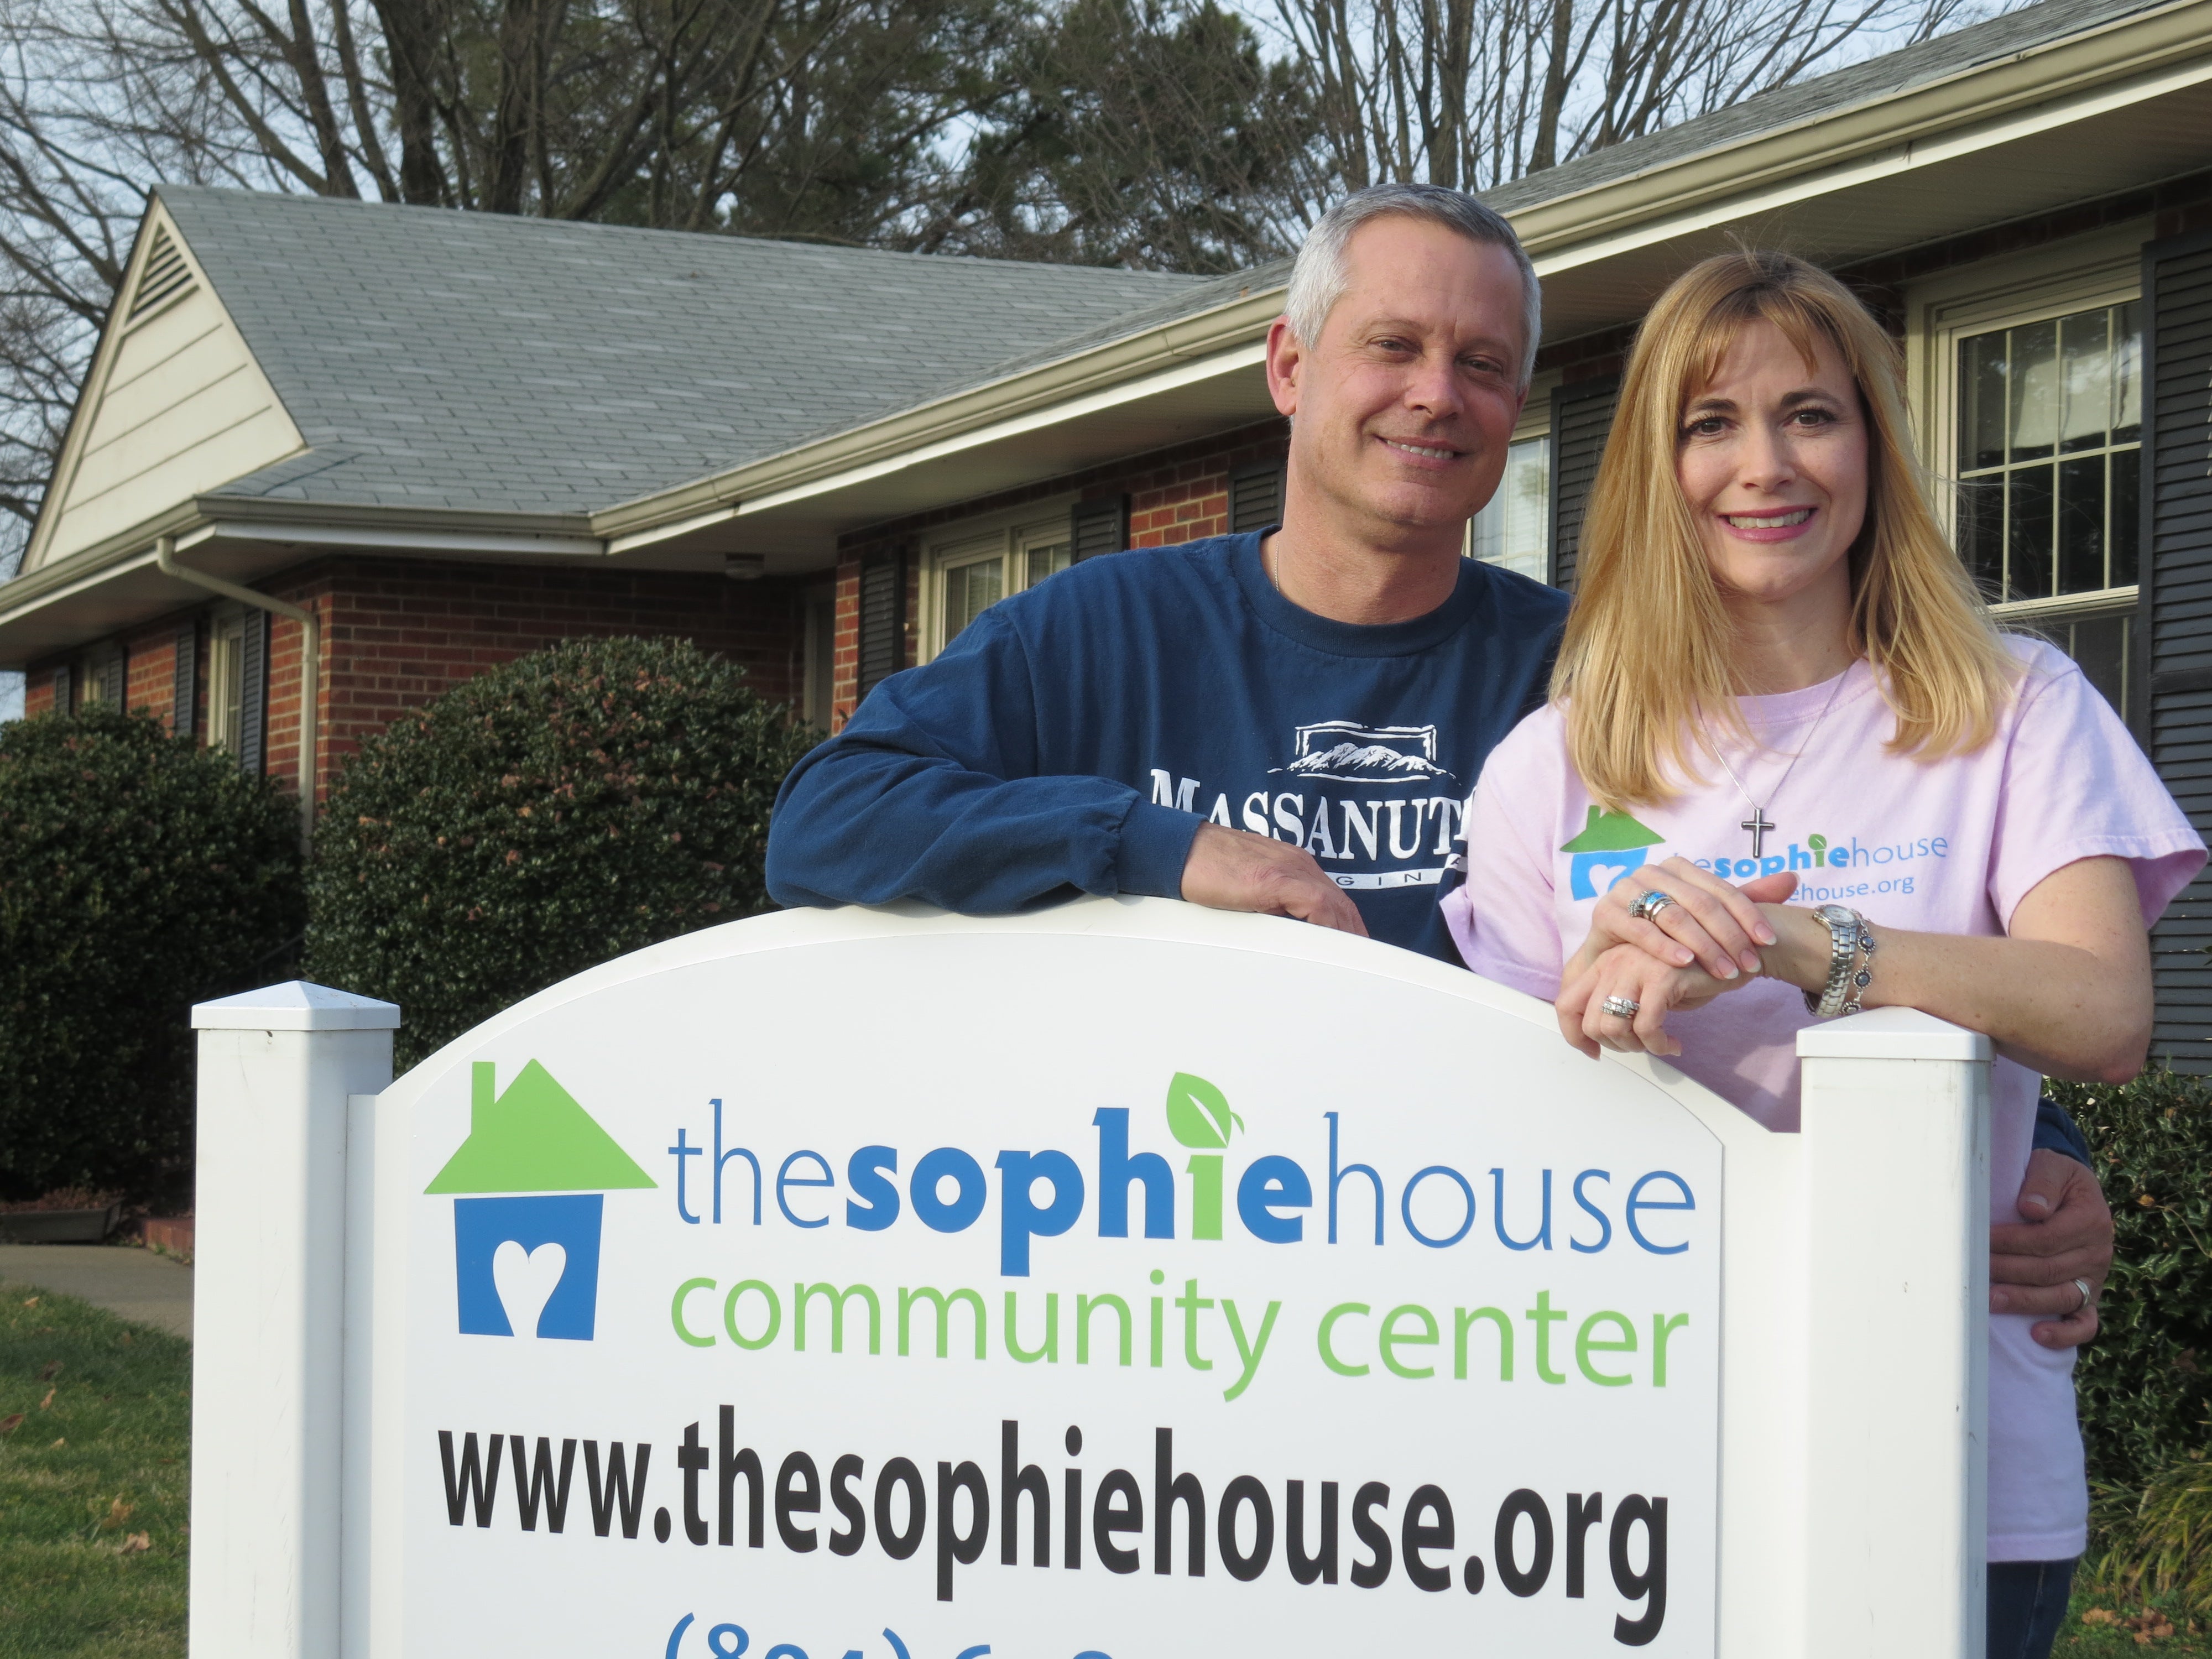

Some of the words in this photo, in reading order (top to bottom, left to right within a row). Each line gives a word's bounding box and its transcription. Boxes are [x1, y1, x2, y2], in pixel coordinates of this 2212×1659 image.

[1673, 833, 1948, 879] esophiehouse
[1789, 875, 1914, 902] ehouse.org
[669, 1072, 1695, 1277] thesophiehouse
[672, 1269, 1280, 1400] community
[1318, 1292, 1688, 1386] center
[438, 1405, 1668, 1646] www.thesophiehouse.org
